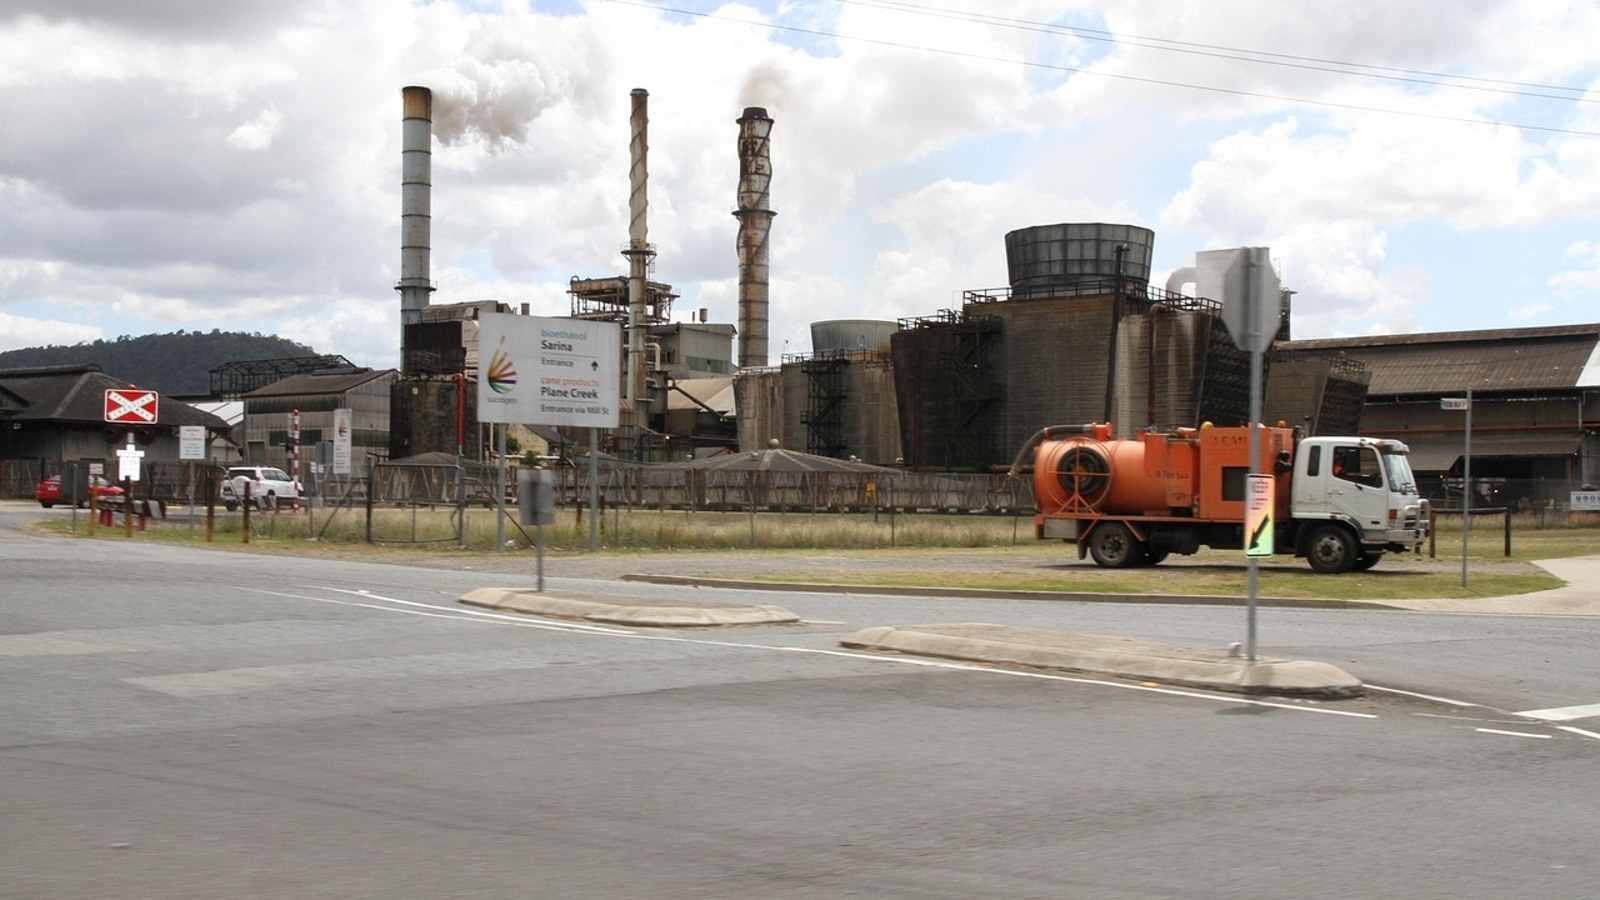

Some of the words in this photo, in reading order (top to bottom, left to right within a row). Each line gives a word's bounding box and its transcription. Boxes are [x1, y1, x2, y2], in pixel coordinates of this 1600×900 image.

[541, 328, 587, 340] bioethanol
[541, 340, 573, 351] Sarina
[541, 357, 574, 367] Entrance
[563, 377, 599, 387] products
[541, 386, 568, 397] Plane
[570, 388, 599, 399] Creek
[541, 404, 574, 414] Entrance
[575, 406, 586, 414] via
[587, 406, 600, 415] Mill
[601, 407, 610, 416] St
